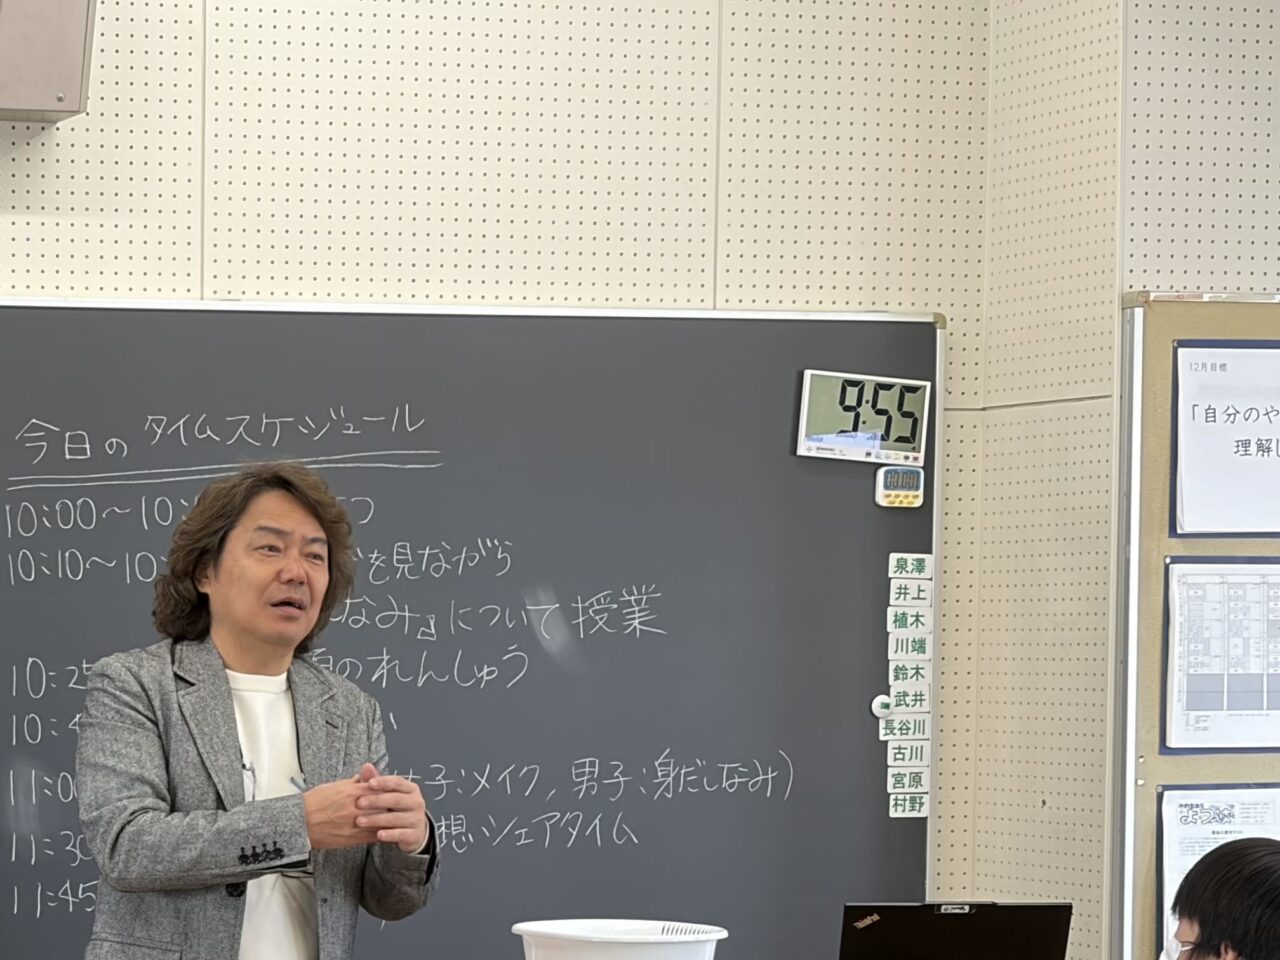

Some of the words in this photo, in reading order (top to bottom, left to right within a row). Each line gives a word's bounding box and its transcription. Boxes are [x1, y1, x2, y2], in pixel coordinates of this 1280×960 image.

[834, 379, 922, 444] 9:55
[895, 584, 927, 601] 井上
[893, 611, 925, 629] 植木
[894, 637, 927, 655] 川端
[893, 664, 925, 682] 鈴木
[894, 691, 926, 708] 武井
[882, 719, 926, 736] 長谷川
[891, 744, 924, 761] 古川
[891, 772, 923, 789] 宮原
[892, 795, 925, 813] 村野
